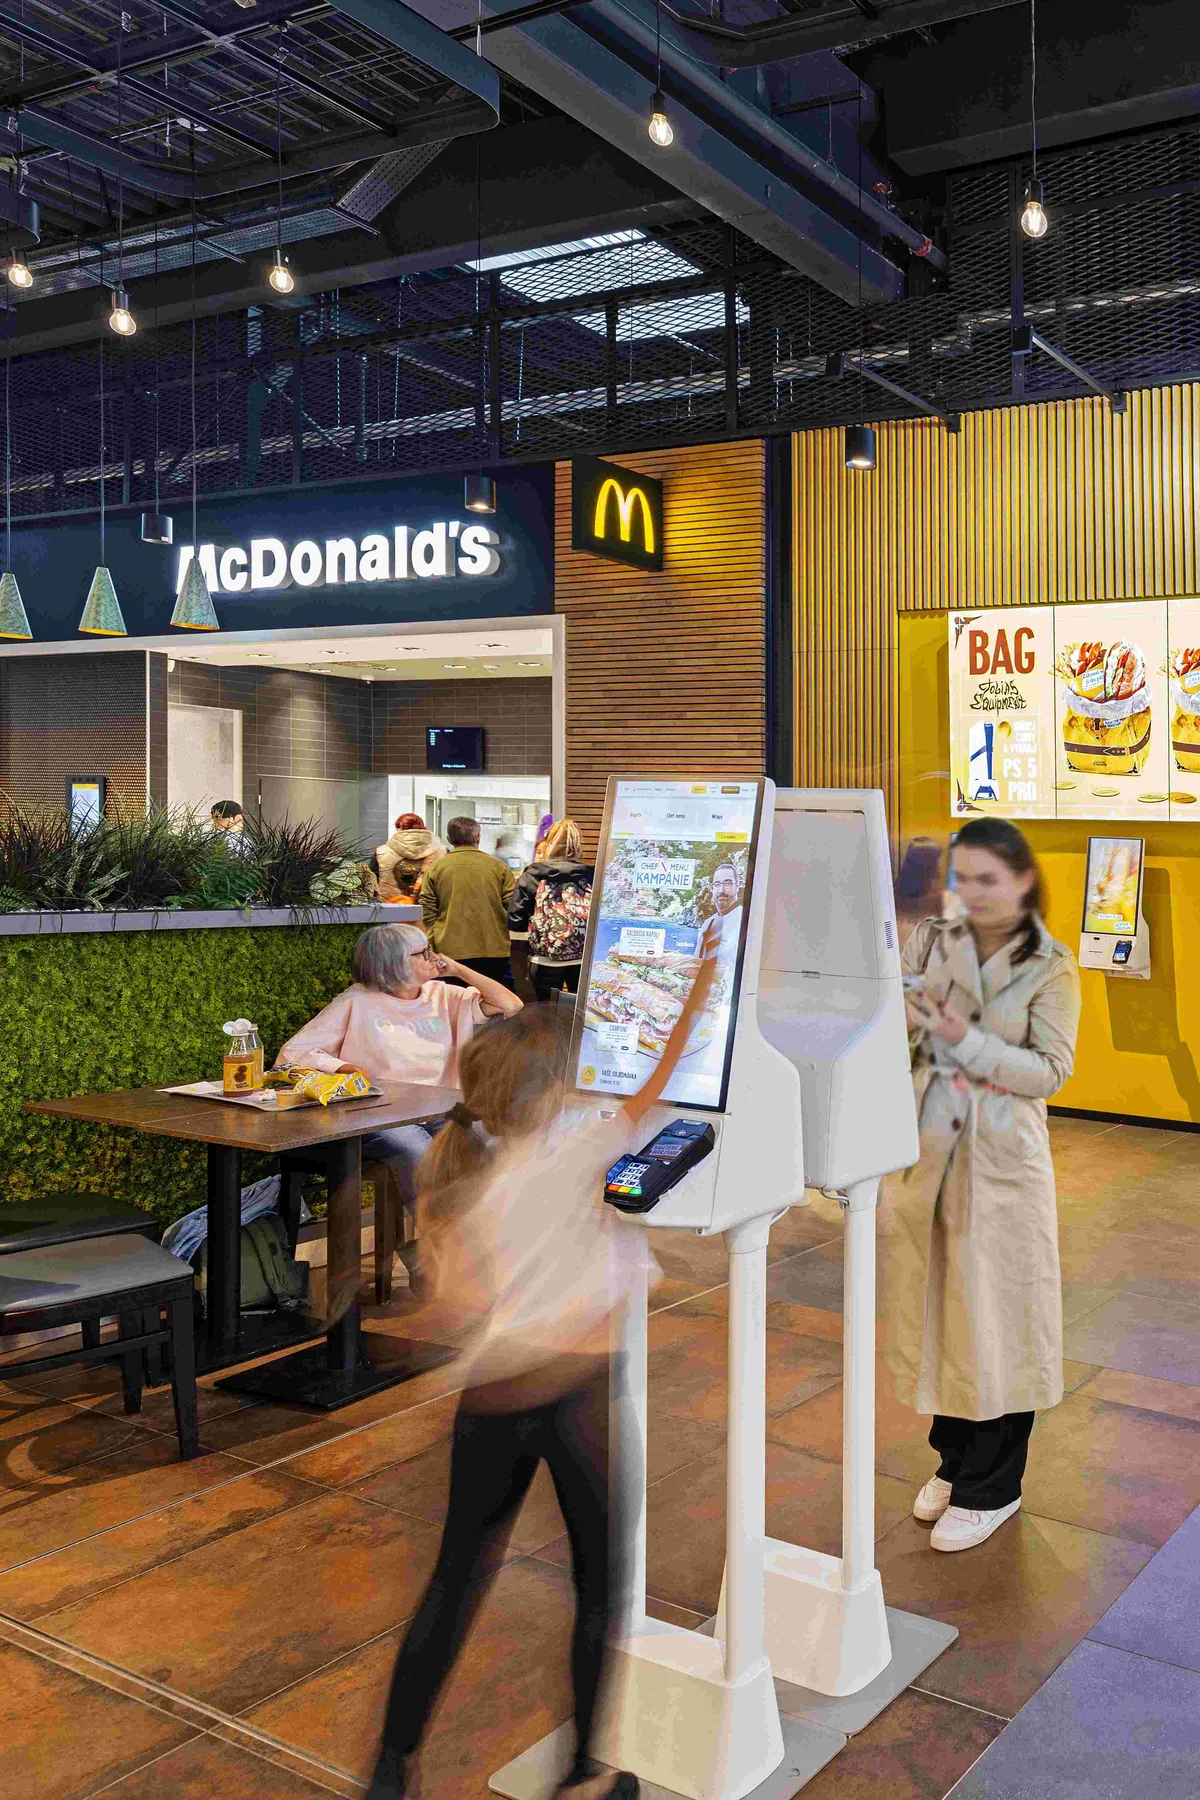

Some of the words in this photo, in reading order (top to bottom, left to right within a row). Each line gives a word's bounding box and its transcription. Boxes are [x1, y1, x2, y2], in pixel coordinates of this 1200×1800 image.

[969, 627, 1035, 676] BAG
[641, 862, 659, 870] CHEF
[670, 863, 689, 871] MENU
[636, 871, 690, 886] KAMPÁNIE
